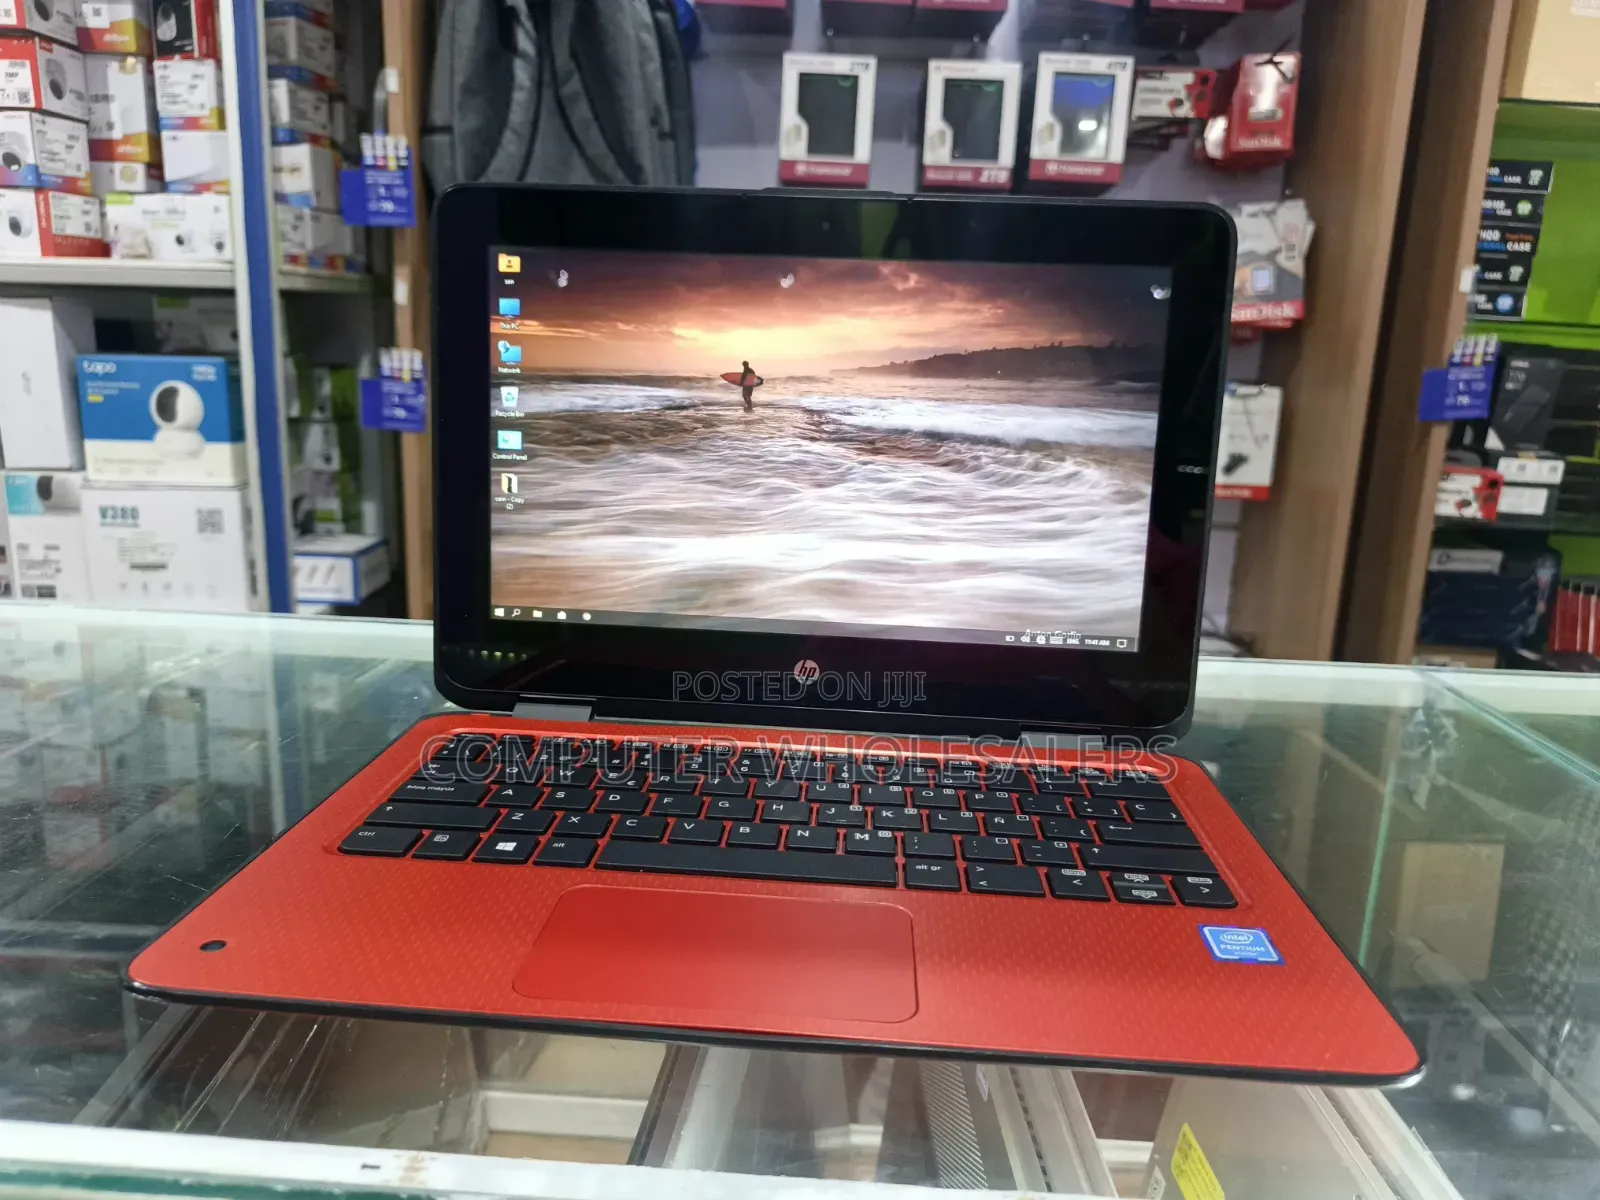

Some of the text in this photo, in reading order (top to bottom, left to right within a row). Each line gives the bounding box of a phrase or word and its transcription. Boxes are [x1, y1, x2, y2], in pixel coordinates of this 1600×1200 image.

[979, 169, 1010, 184] 2TB
[1506, 242, 1532, 252] CASE
[498, 366, 521, 374] Network
[513, 453, 527, 461] Panel
[797, 660, 818, 684] hp
[683, 822, 695, 830] V
[854, 832, 870, 841] M
[1220, 943, 1266, 952] PENTIUM
